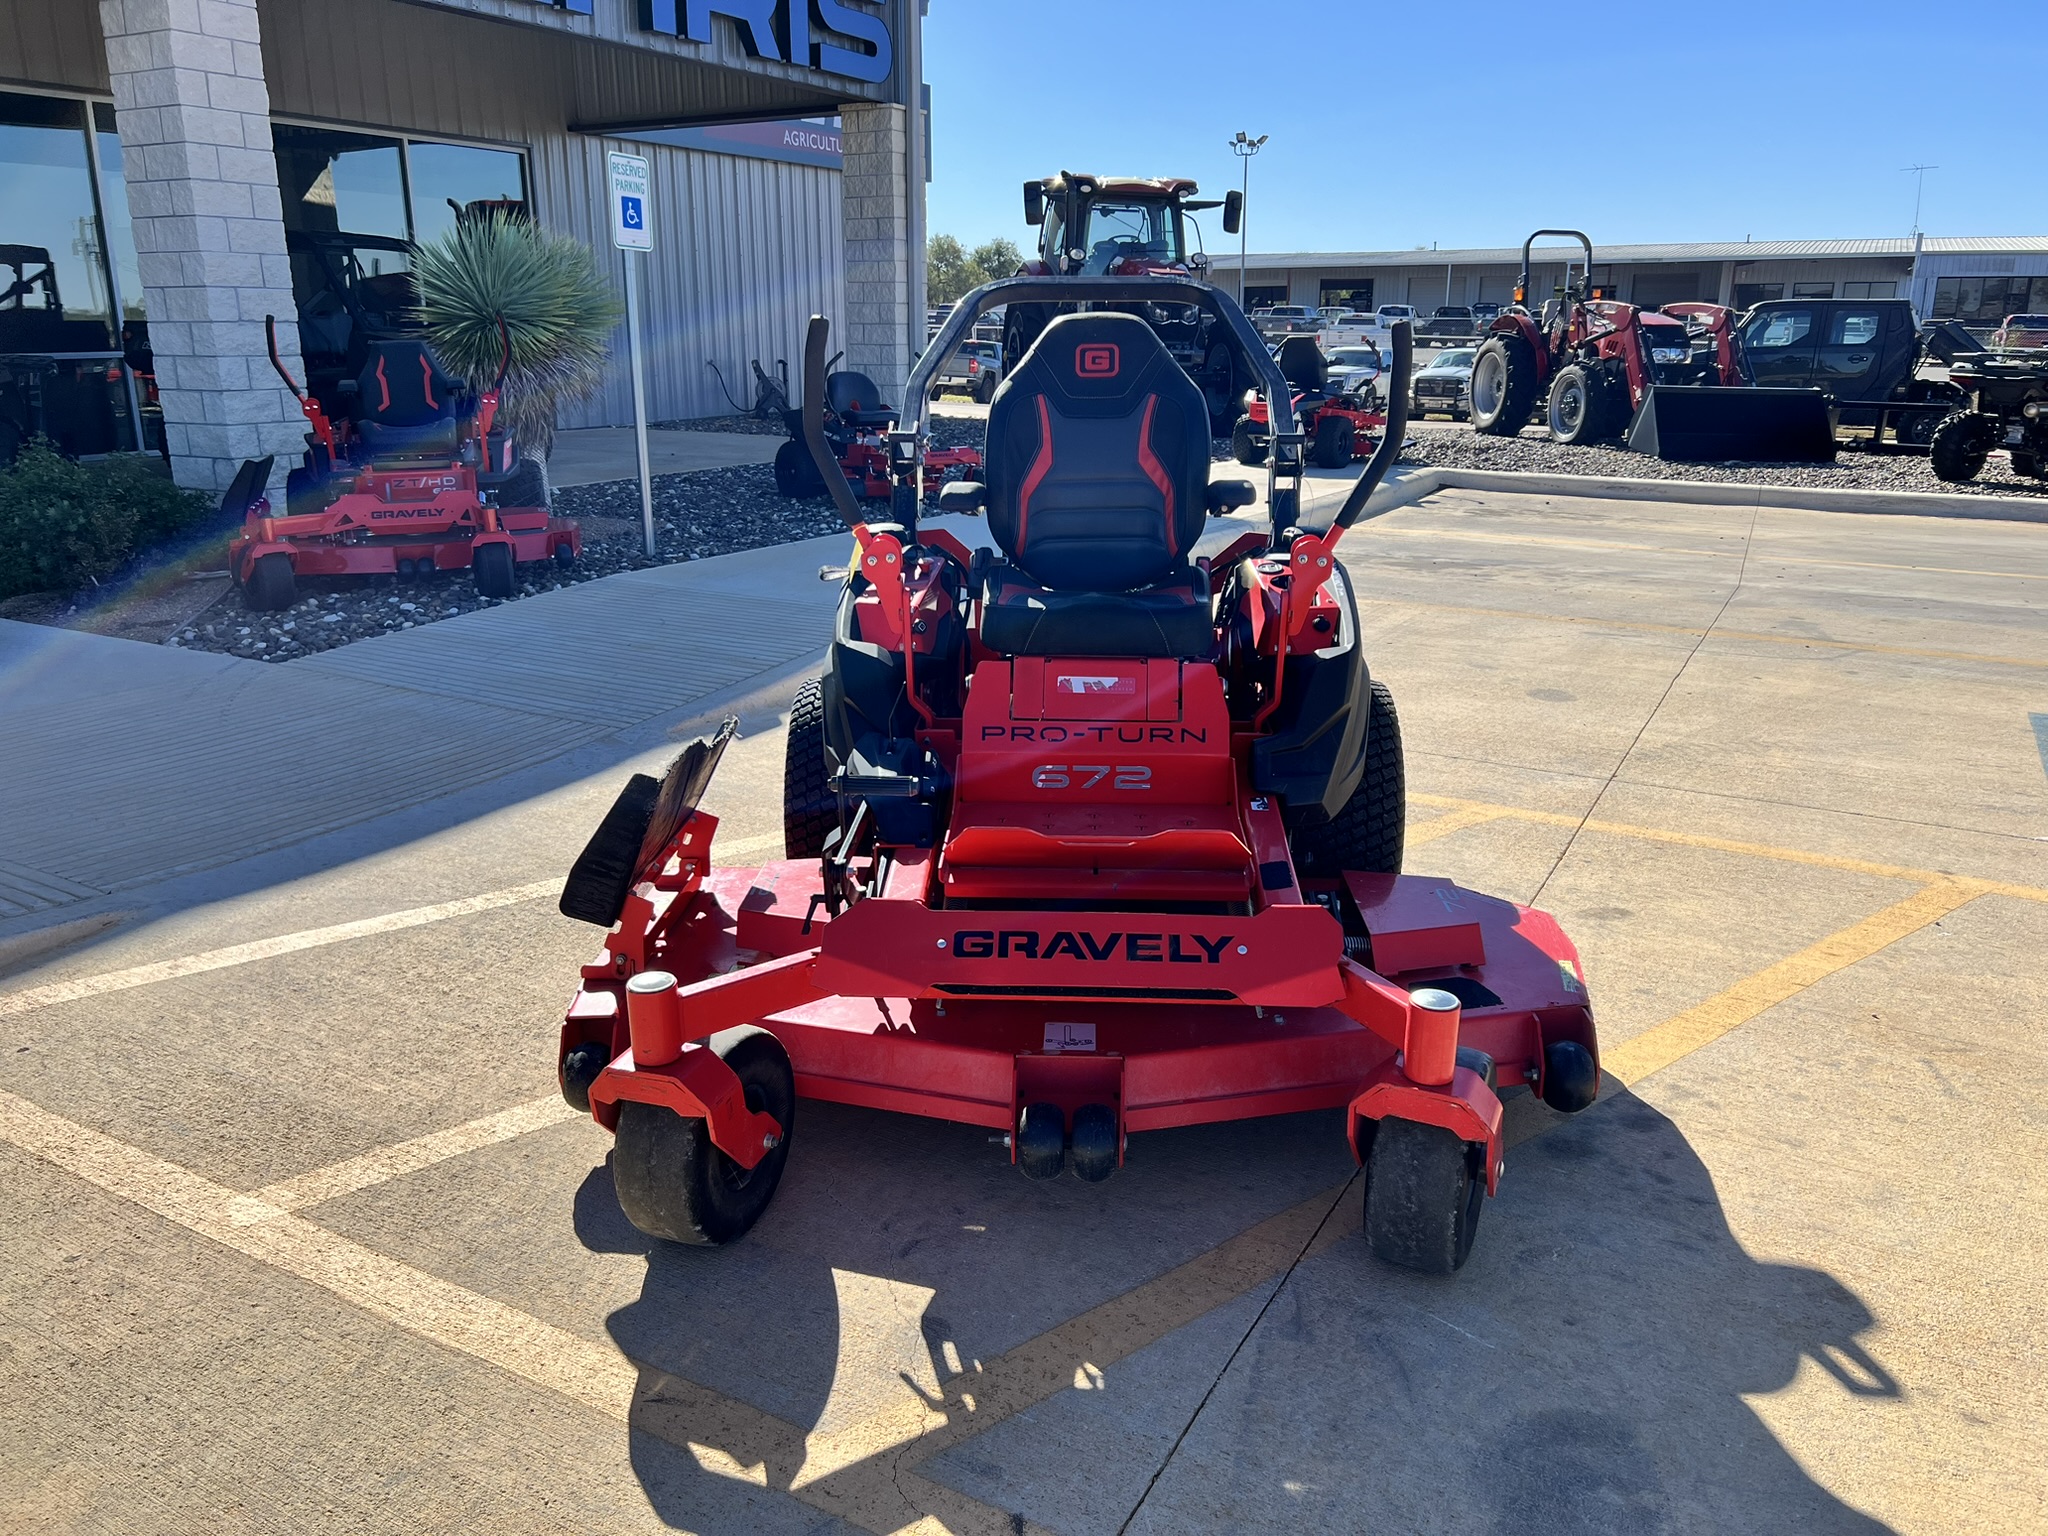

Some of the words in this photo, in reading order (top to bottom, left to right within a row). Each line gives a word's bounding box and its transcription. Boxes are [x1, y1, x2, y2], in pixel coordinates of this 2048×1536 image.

[612, 162, 647, 179] RESERVED
[615, 178, 645, 195] PARKING
[393, 477, 456, 489] ZT/HD
[371, 508, 446, 519] GRAVELY
[981, 726, 1206, 743] PRO-TURN
[1031, 765, 1152, 789] 672
[953, 930, 1236, 964] GRAVELY
